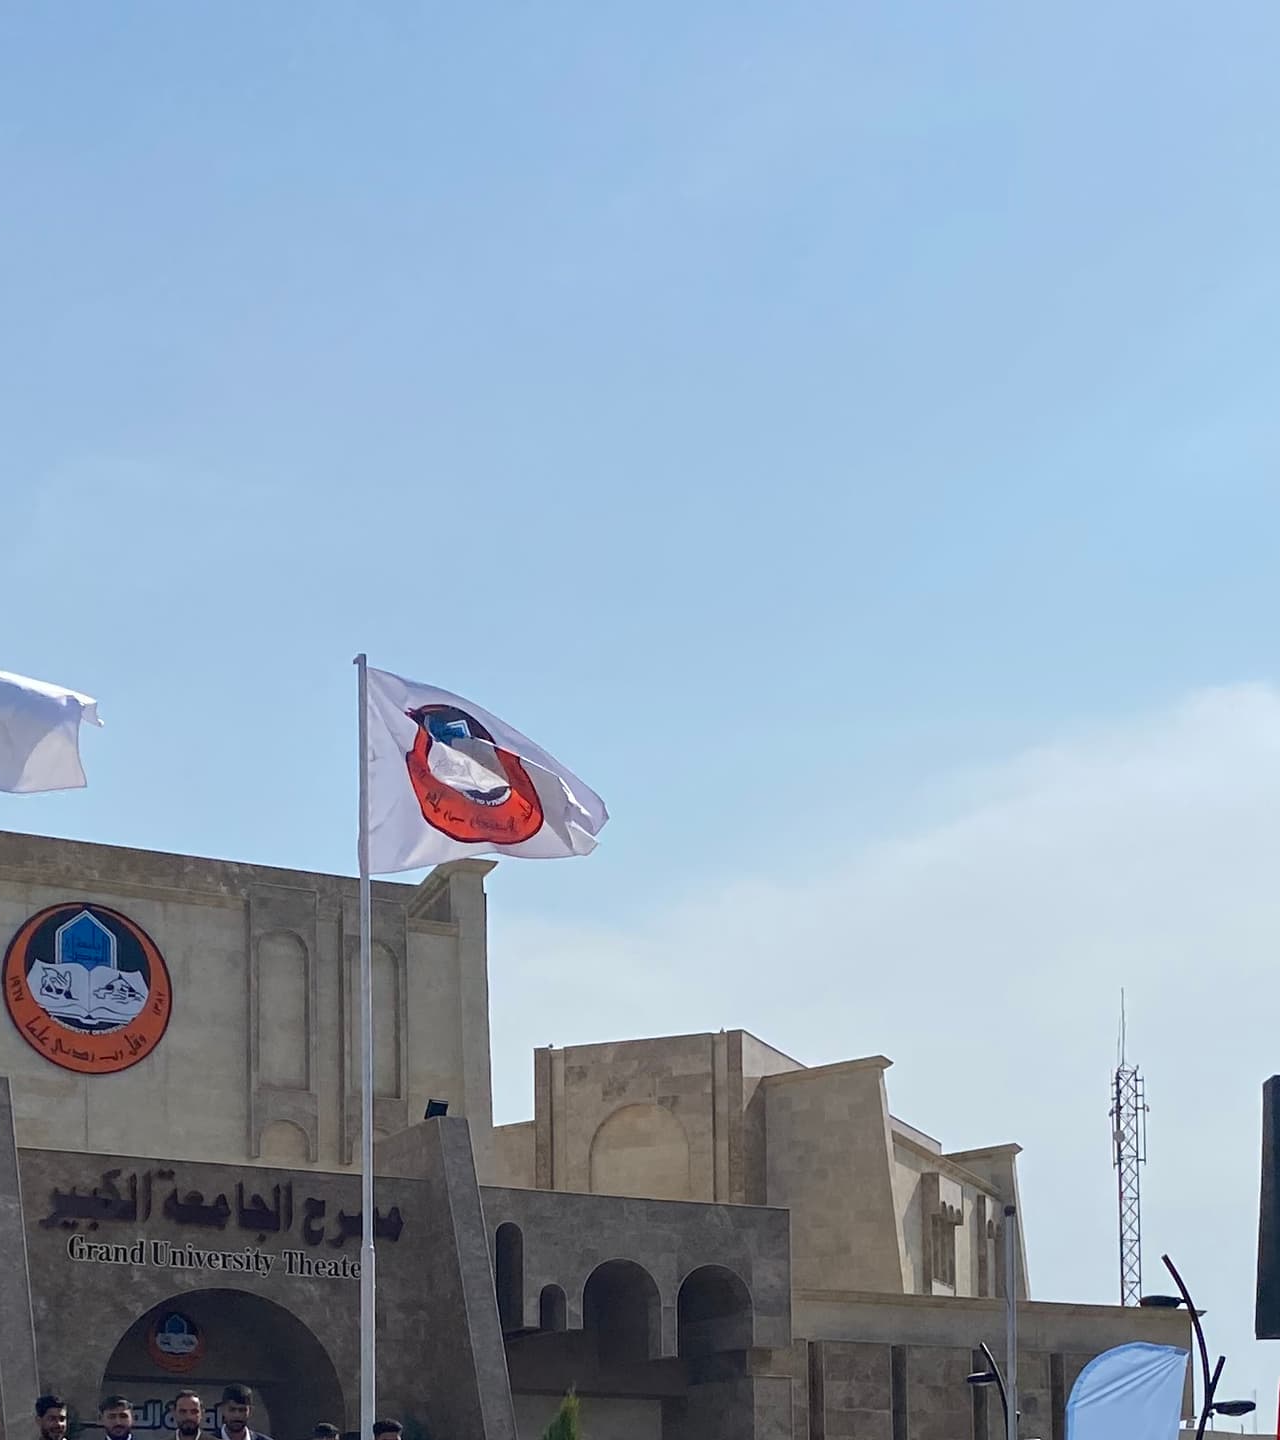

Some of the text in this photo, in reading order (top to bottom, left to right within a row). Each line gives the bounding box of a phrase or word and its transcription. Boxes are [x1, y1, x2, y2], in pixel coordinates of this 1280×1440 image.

[38, 1168, 405, 1248] مسرح الجامعة الكبير
[67, 1233, 362, 1280] Grand University Theate
